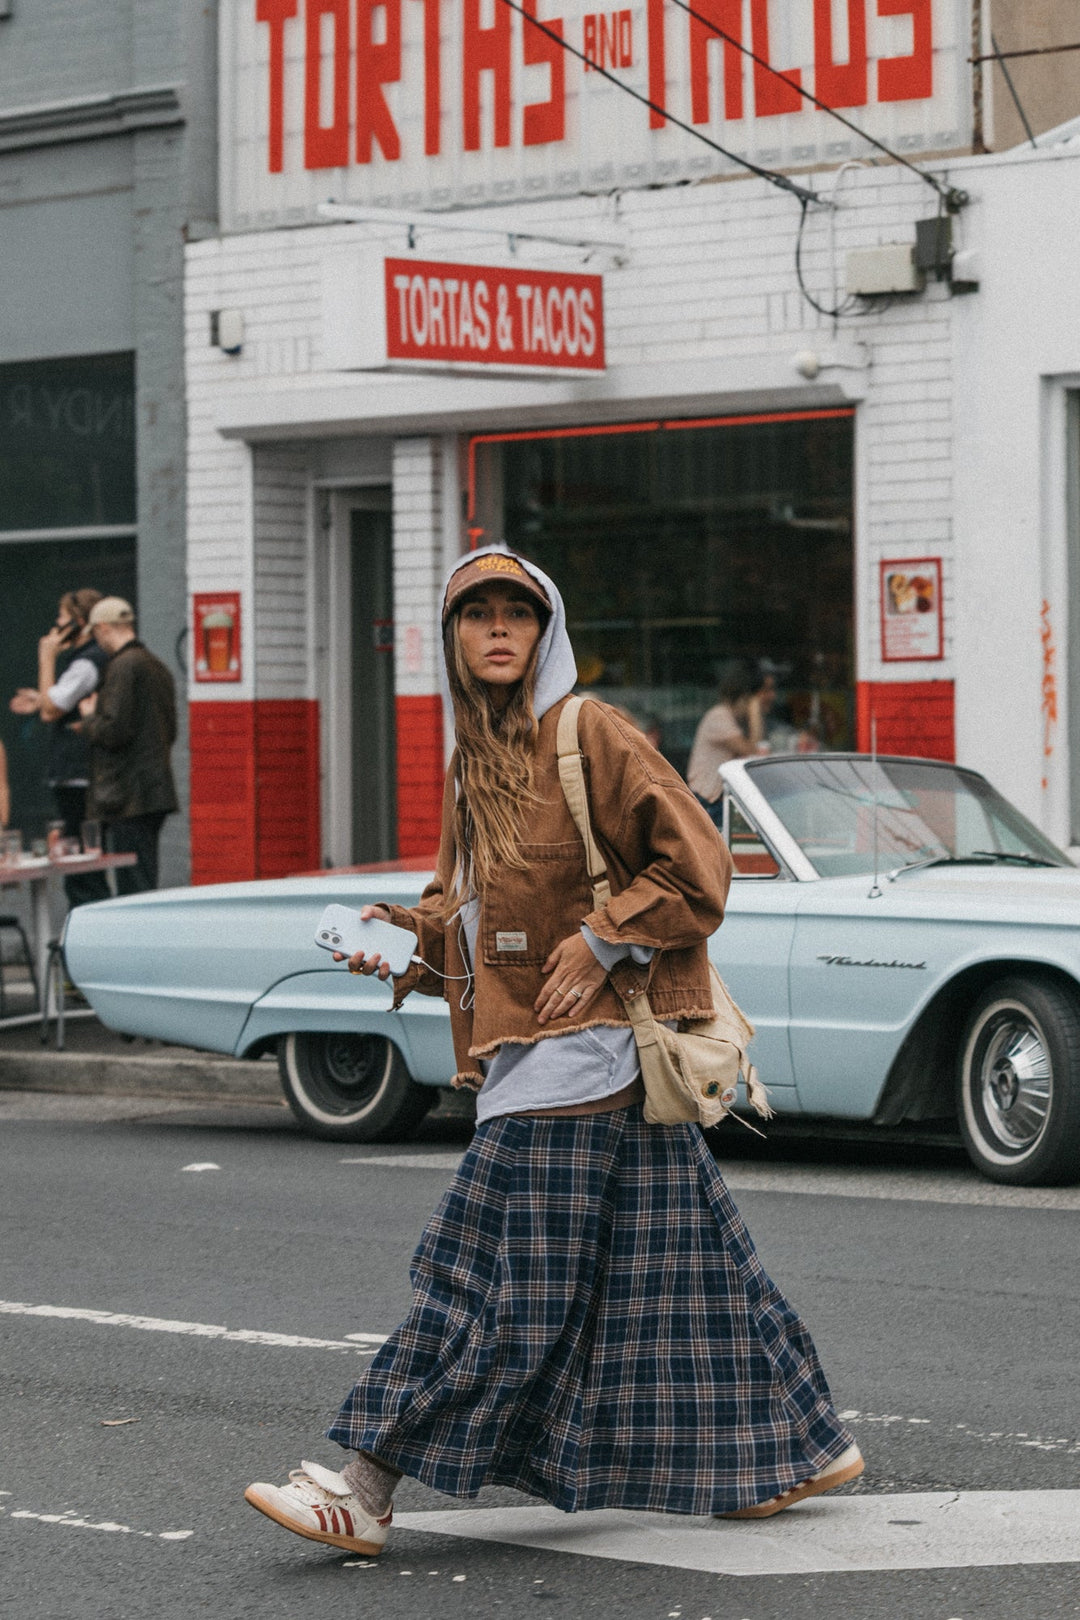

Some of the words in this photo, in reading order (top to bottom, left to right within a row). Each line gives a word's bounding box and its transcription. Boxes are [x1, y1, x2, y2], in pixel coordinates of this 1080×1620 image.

[255, 0, 565, 173] TORTAS
[583, 9, 633, 73] AND
[394, 274, 491, 350] TORTAS
[496, 284, 515, 351] &
[516, 284, 596, 356] TACOS
[816, 954, 927, 970] Thunderbird
